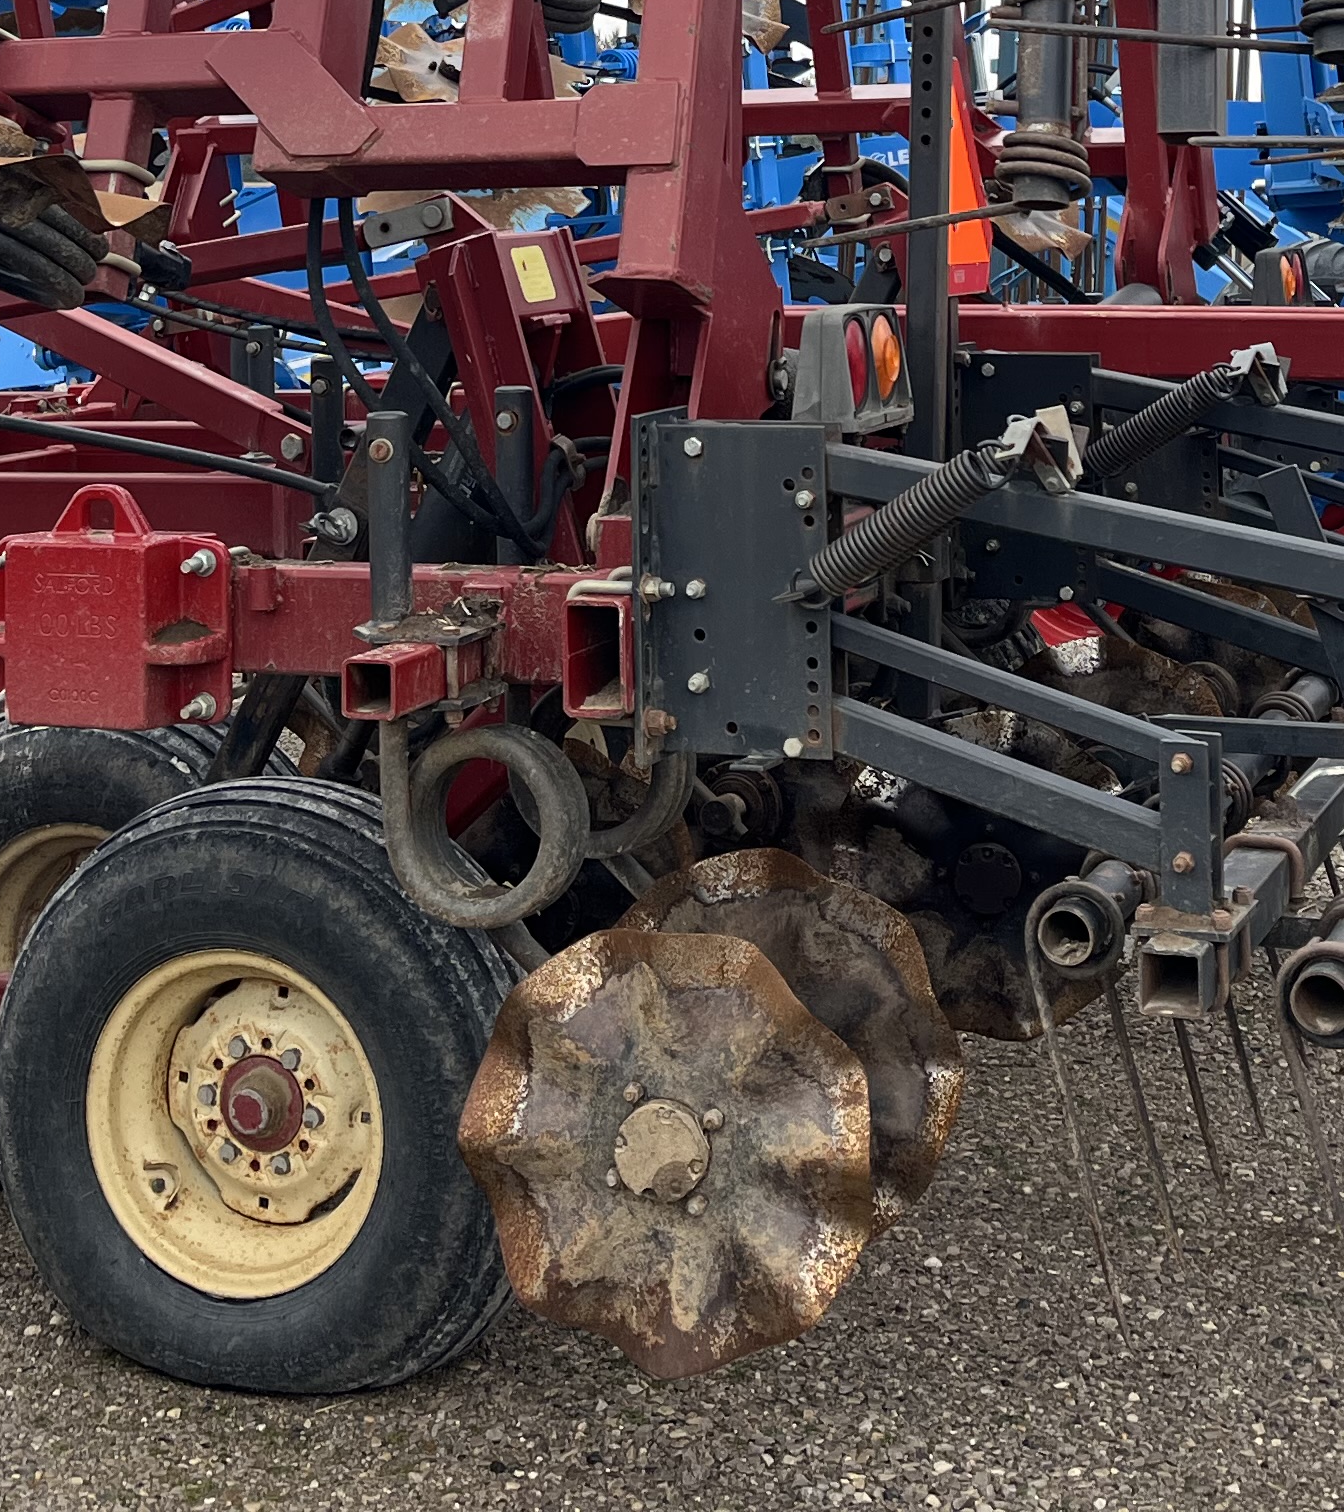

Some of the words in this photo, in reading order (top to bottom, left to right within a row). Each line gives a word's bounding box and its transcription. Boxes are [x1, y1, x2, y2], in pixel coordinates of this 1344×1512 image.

[887, 148, 910, 167] LE
[32, 571, 116, 596] SALFORD
[32, 613, 69, 638] 100
[75, 614, 118, 640] LBS
